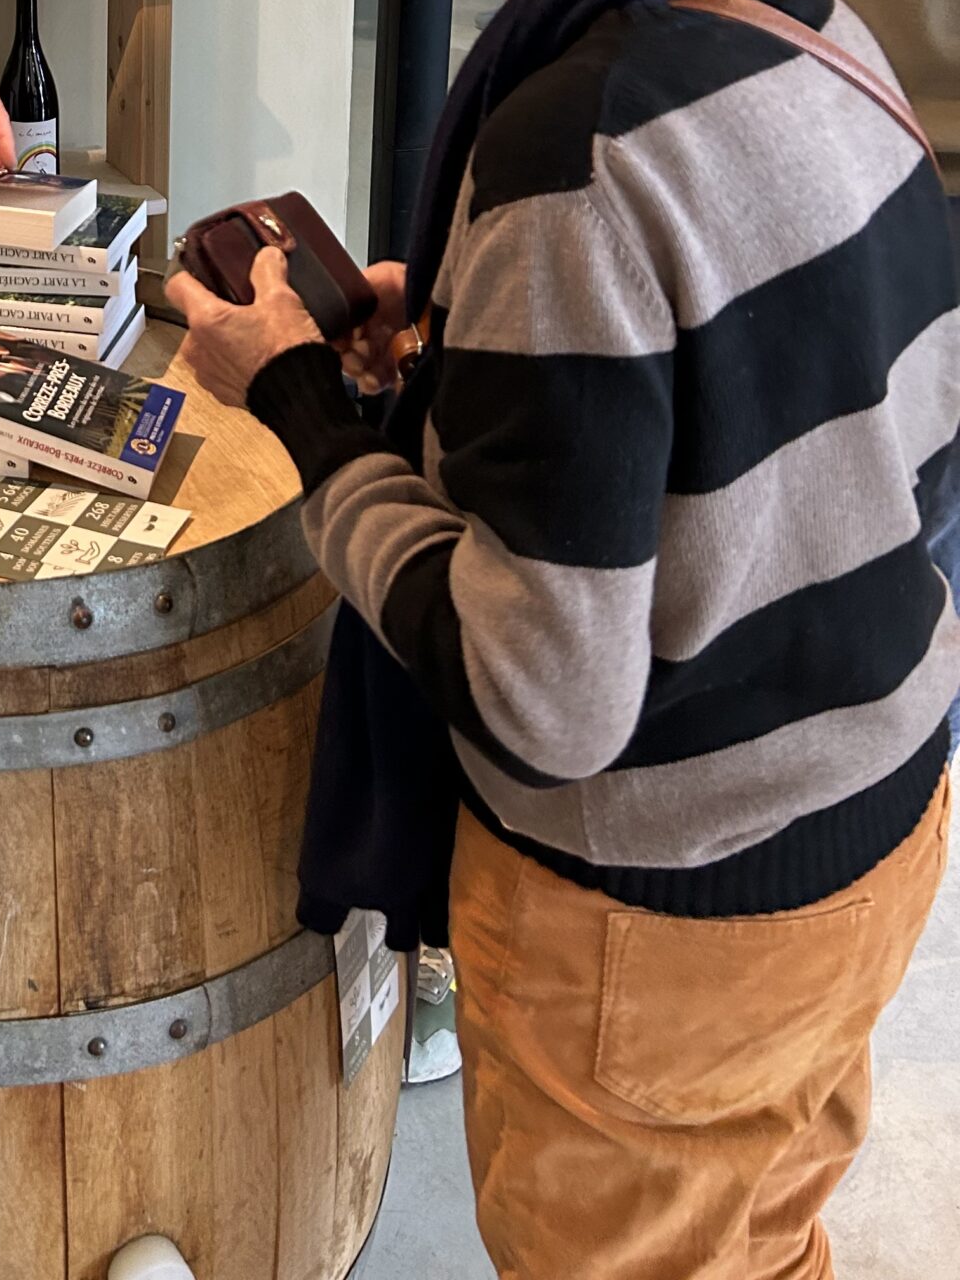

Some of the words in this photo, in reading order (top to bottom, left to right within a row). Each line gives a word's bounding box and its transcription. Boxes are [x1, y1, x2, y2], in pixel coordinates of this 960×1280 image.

[31, 249, 58, 263] PART
[60, 252, 75, 263] LA
[43, 276, 69, 287] PART
[73, 277, 86, 287] LA
[27, 311, 53, 321] PART
[56, 313, 70, 323] LA
[51, 340, 65, 349] LA
[22, 358, 70, 422] CORRÈZE-PRÈS-
[46, 373, 87, 420] BORDEAUX
[85, 501, 110, 520] 268
[10, 527, 30, 543] 40
[107, 554, 124, 564] 8
